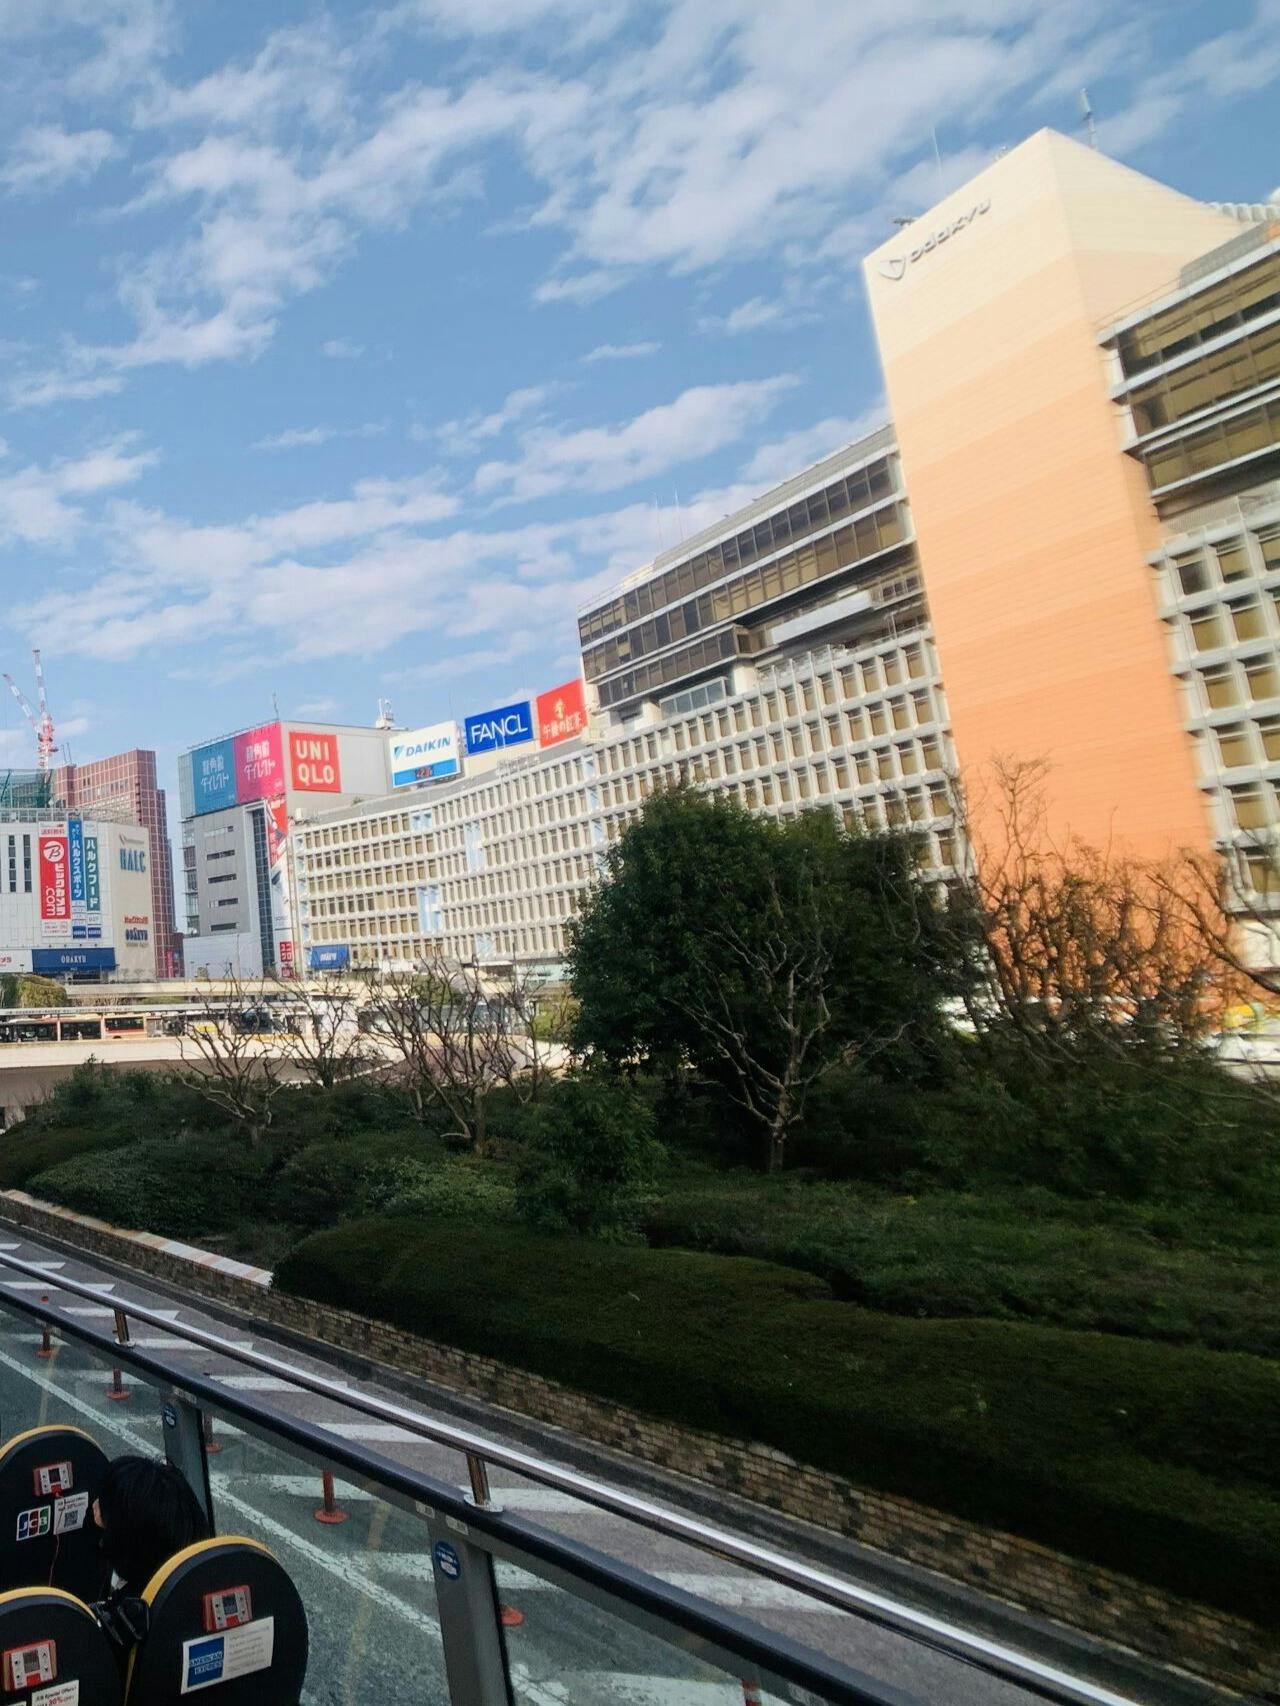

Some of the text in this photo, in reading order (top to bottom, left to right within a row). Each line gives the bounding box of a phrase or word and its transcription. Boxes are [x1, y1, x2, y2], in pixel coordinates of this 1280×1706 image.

[470, 713, 529, 744] FANCL
[295, 738, 330, 761] UNI
[405, 736, 452, 758] DAIKIN
[297, 762, 336, 787] QLO
[119, 848, 146, 873] HALC
[86, 839, 99, 909] ハルクフード
[61, 954, 87, 964] ODAKYU
